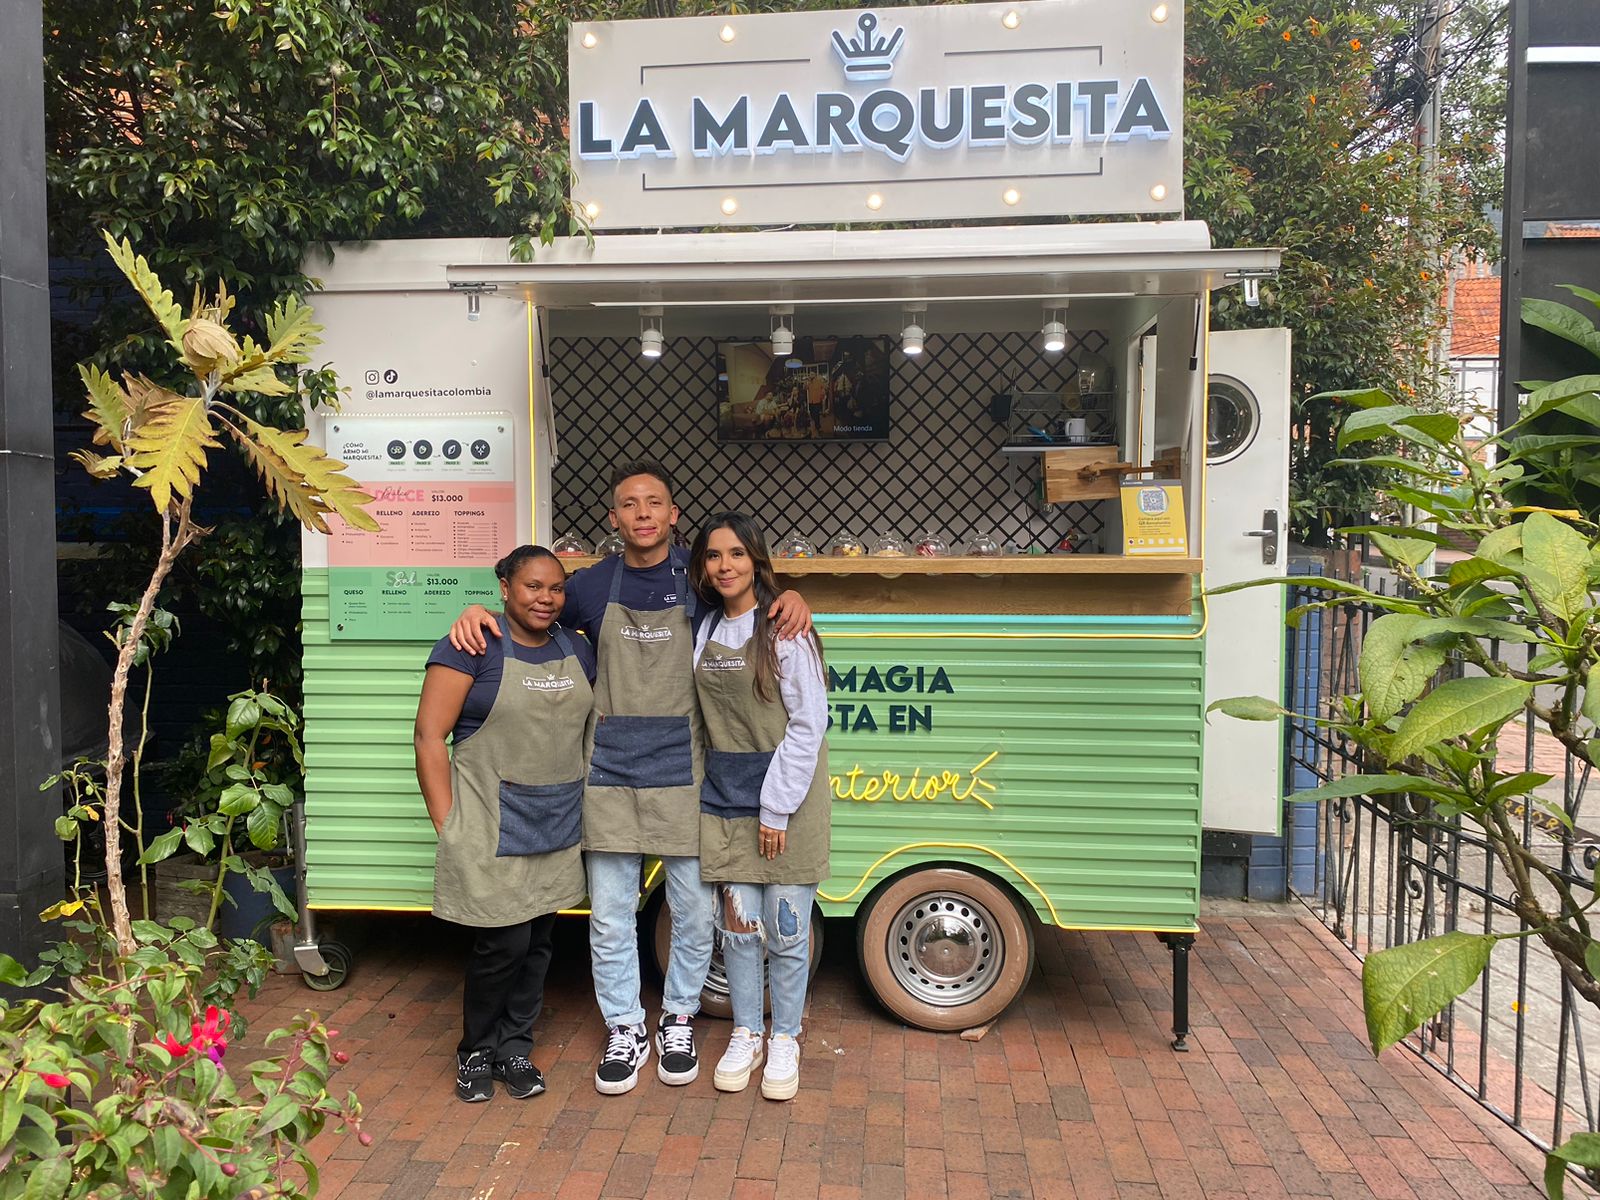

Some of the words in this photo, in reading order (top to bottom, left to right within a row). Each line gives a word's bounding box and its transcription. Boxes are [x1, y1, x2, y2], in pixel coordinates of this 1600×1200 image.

[579, 98, 675, 159] LA
[692, 77, 1172, 161] MARQUESITA
[366, 387, 492, 400] @lamarquesitacolombia
[833, 425, 851, 433] Modo
[852, 423, 873, 433] tienda
[431, 494, 463, 502] $13.000
[426, 578, 458, 586] $13.000
[621, 628, 630, 636] LA
[828, 665, 955, 694] MAGIA
[889, 704, 933, 732] EN
